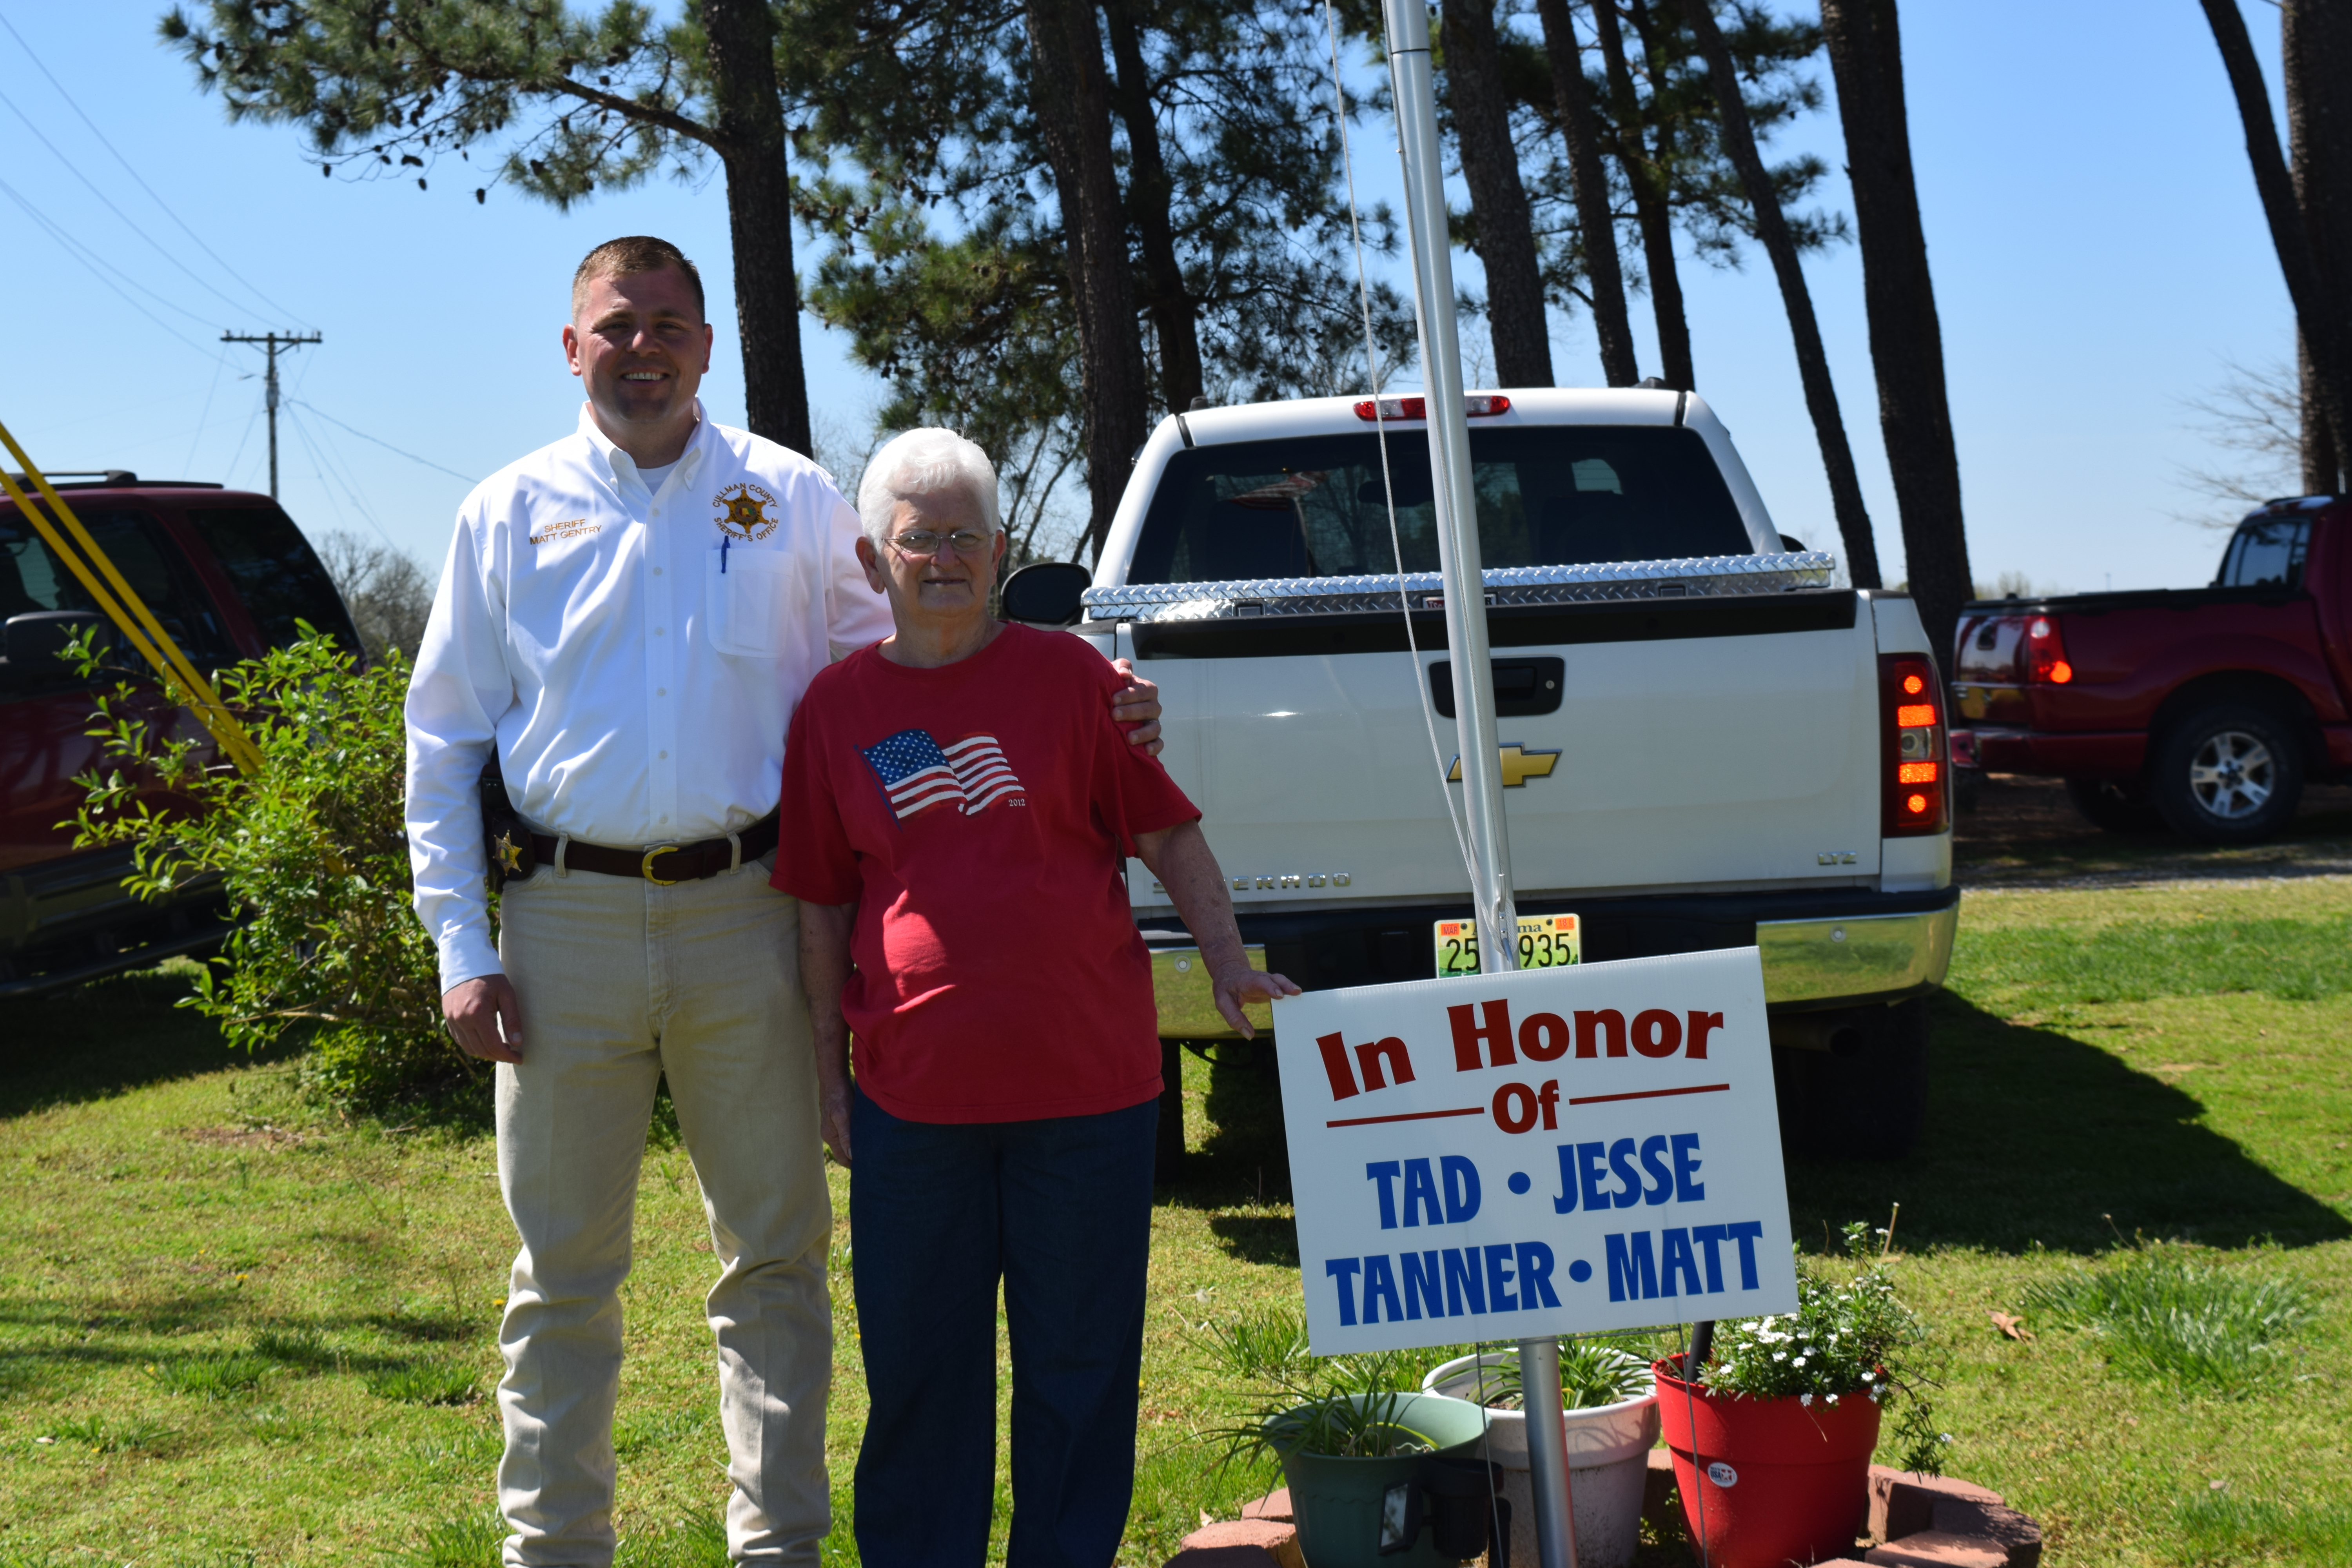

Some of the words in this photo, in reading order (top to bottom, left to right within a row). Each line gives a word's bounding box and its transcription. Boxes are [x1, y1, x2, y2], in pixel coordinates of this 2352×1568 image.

[712, 483, 746, 508] CULLMAN
[749, 484, 778, 508] COUNTY
[529, 532, 557, 545] MATT
[560, 525, 602, 539] GENTRY
[544, 519, 586, 533] SHERIFF
[714, 517, 753, 542] SHERIFF'S
[756, 517, 779, 540] OFFICE
[1008, 799, 1025, 807] 2012
[1817, 851, 1857, 866] LTZ
[1152, 872, 1351, 894] SERADO
[1444, 926, 1457, 935] MAR
[1558, 918, 1567, 927] 18
[1316, 1031, 1416, 1101] In
[1447, 998, 1724, 1072] Honor
[1492, 1079, 1560, 1134] Of
[1366, 1155, 1481, 1230] TAD
[1553, 1132, 1705, 1214] JESSE
[1325, 1241, 1562, 1326] TANNER
[1604, 1221, 1762, 1302] MATT
